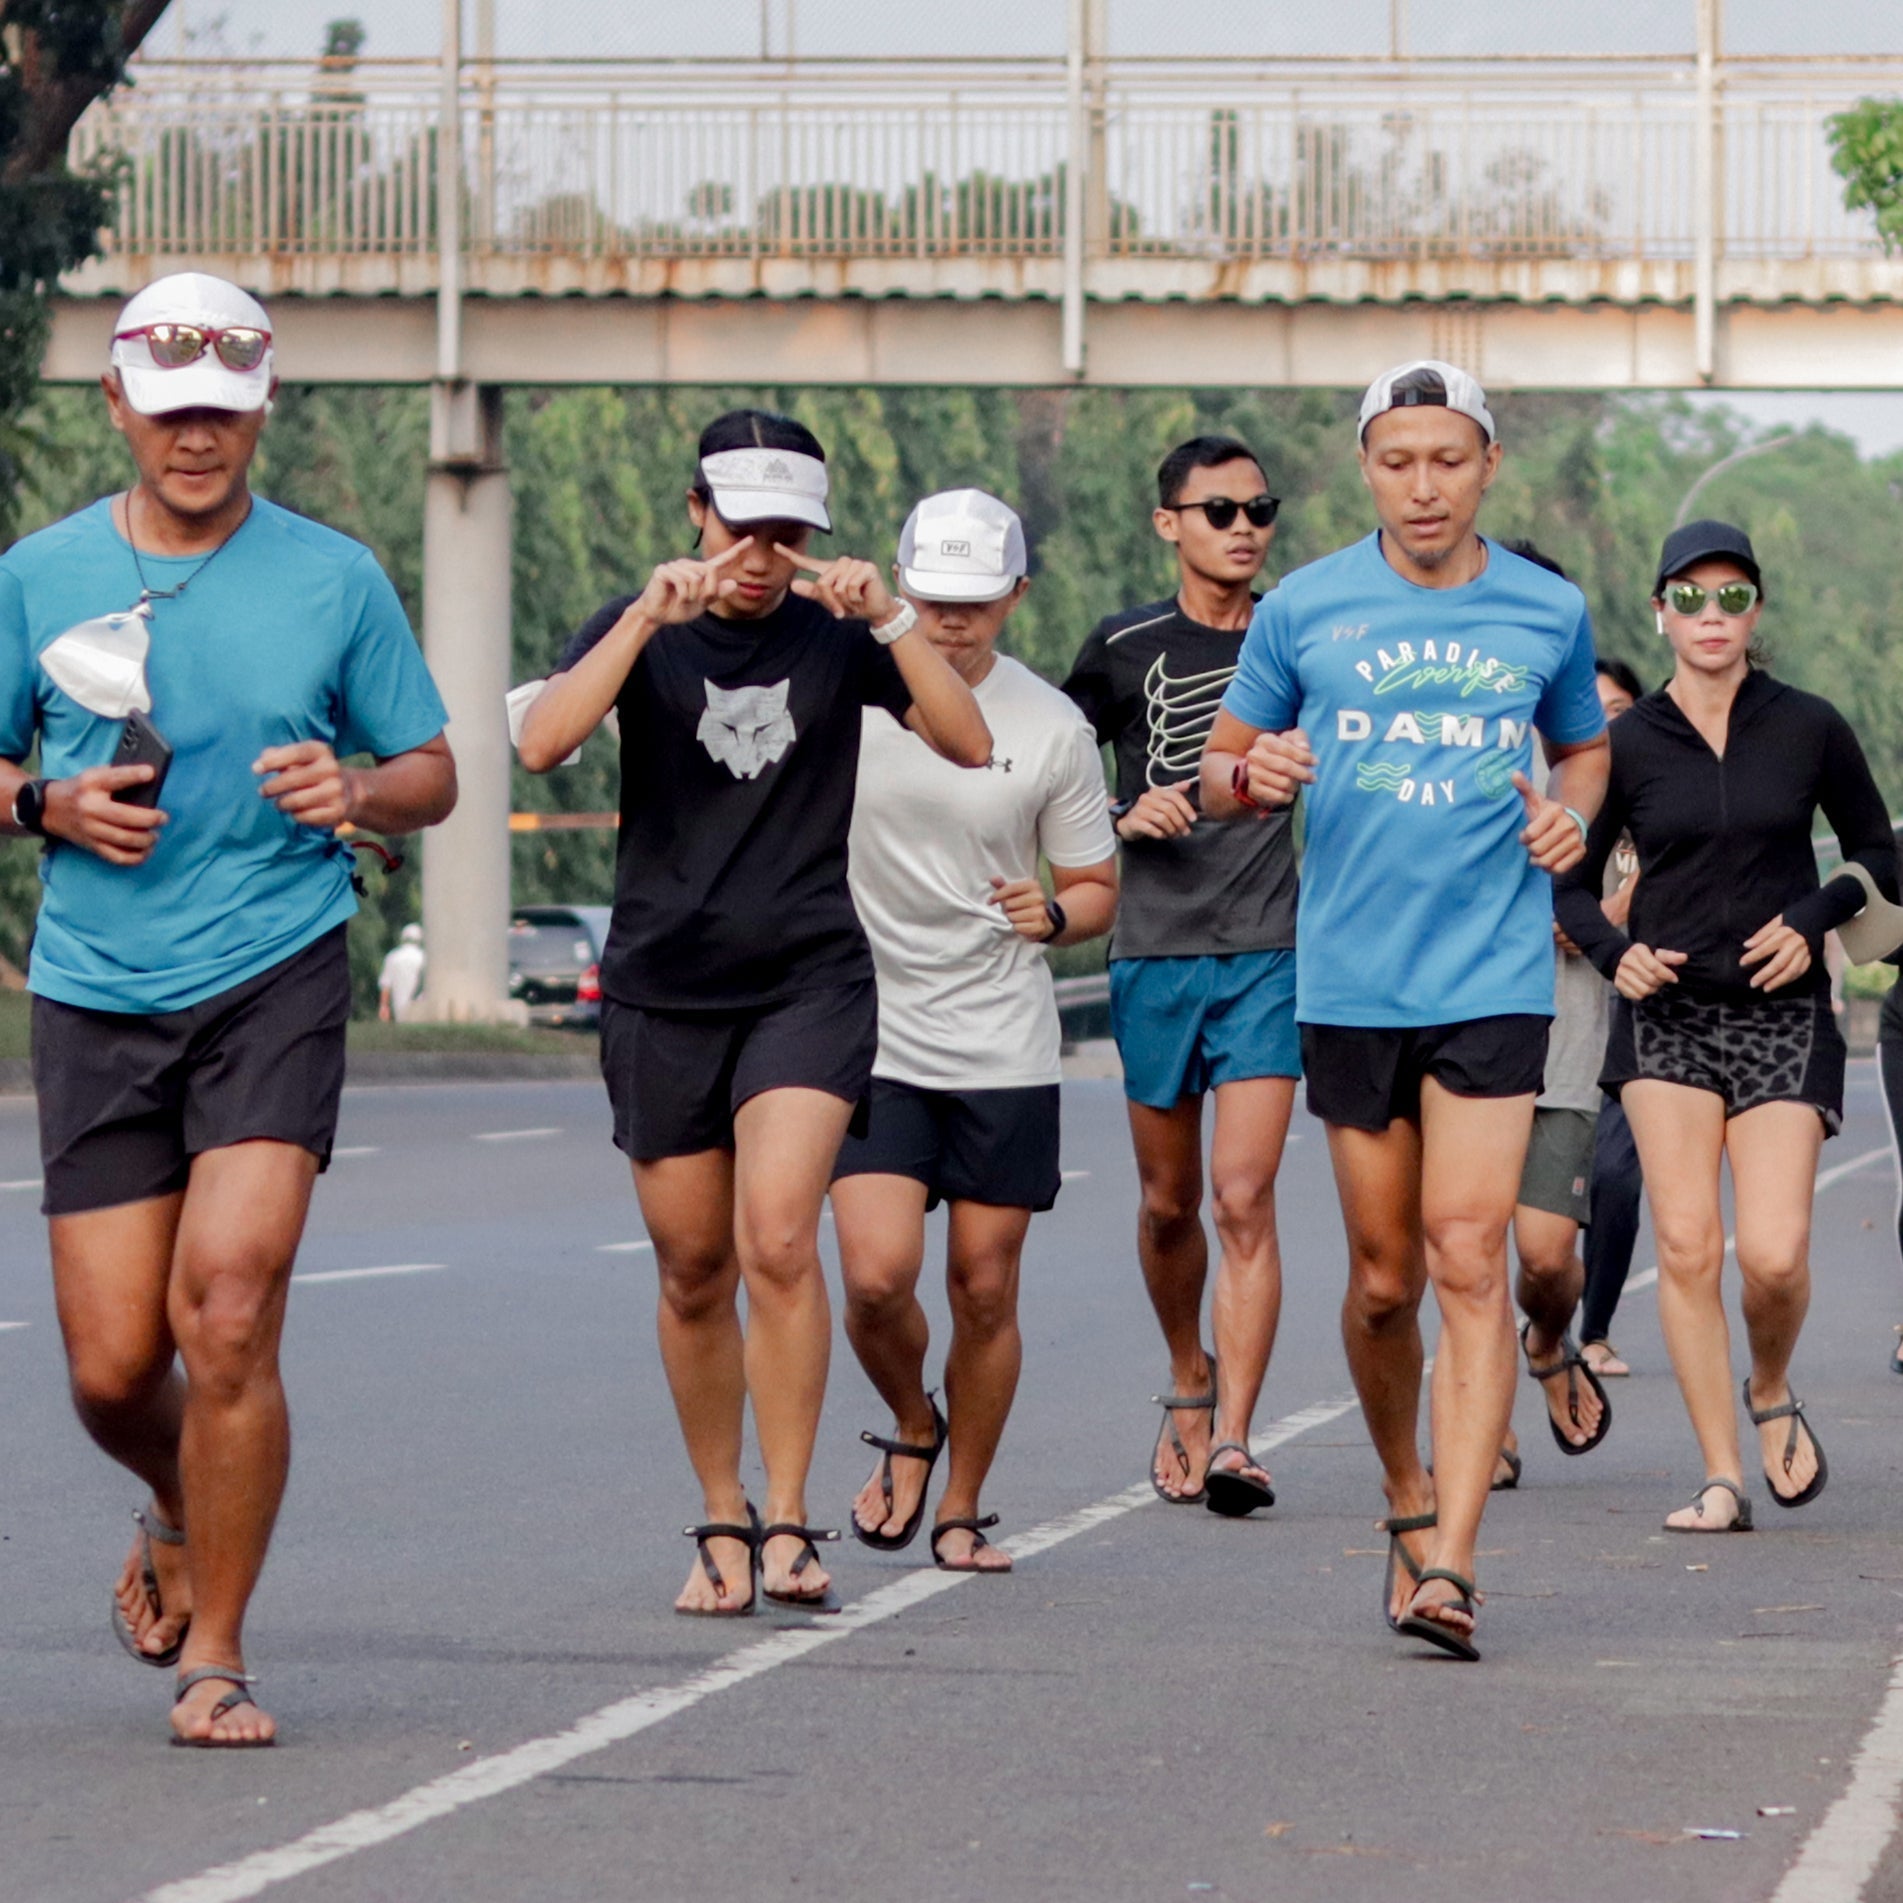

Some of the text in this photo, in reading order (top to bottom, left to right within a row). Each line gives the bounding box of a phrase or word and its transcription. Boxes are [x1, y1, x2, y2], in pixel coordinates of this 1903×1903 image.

[1355, 640, 1517, 694] PARADISE
[1337, 709, 1527, 749] DAMN
[1397, 778, 1455, 805] DAY
